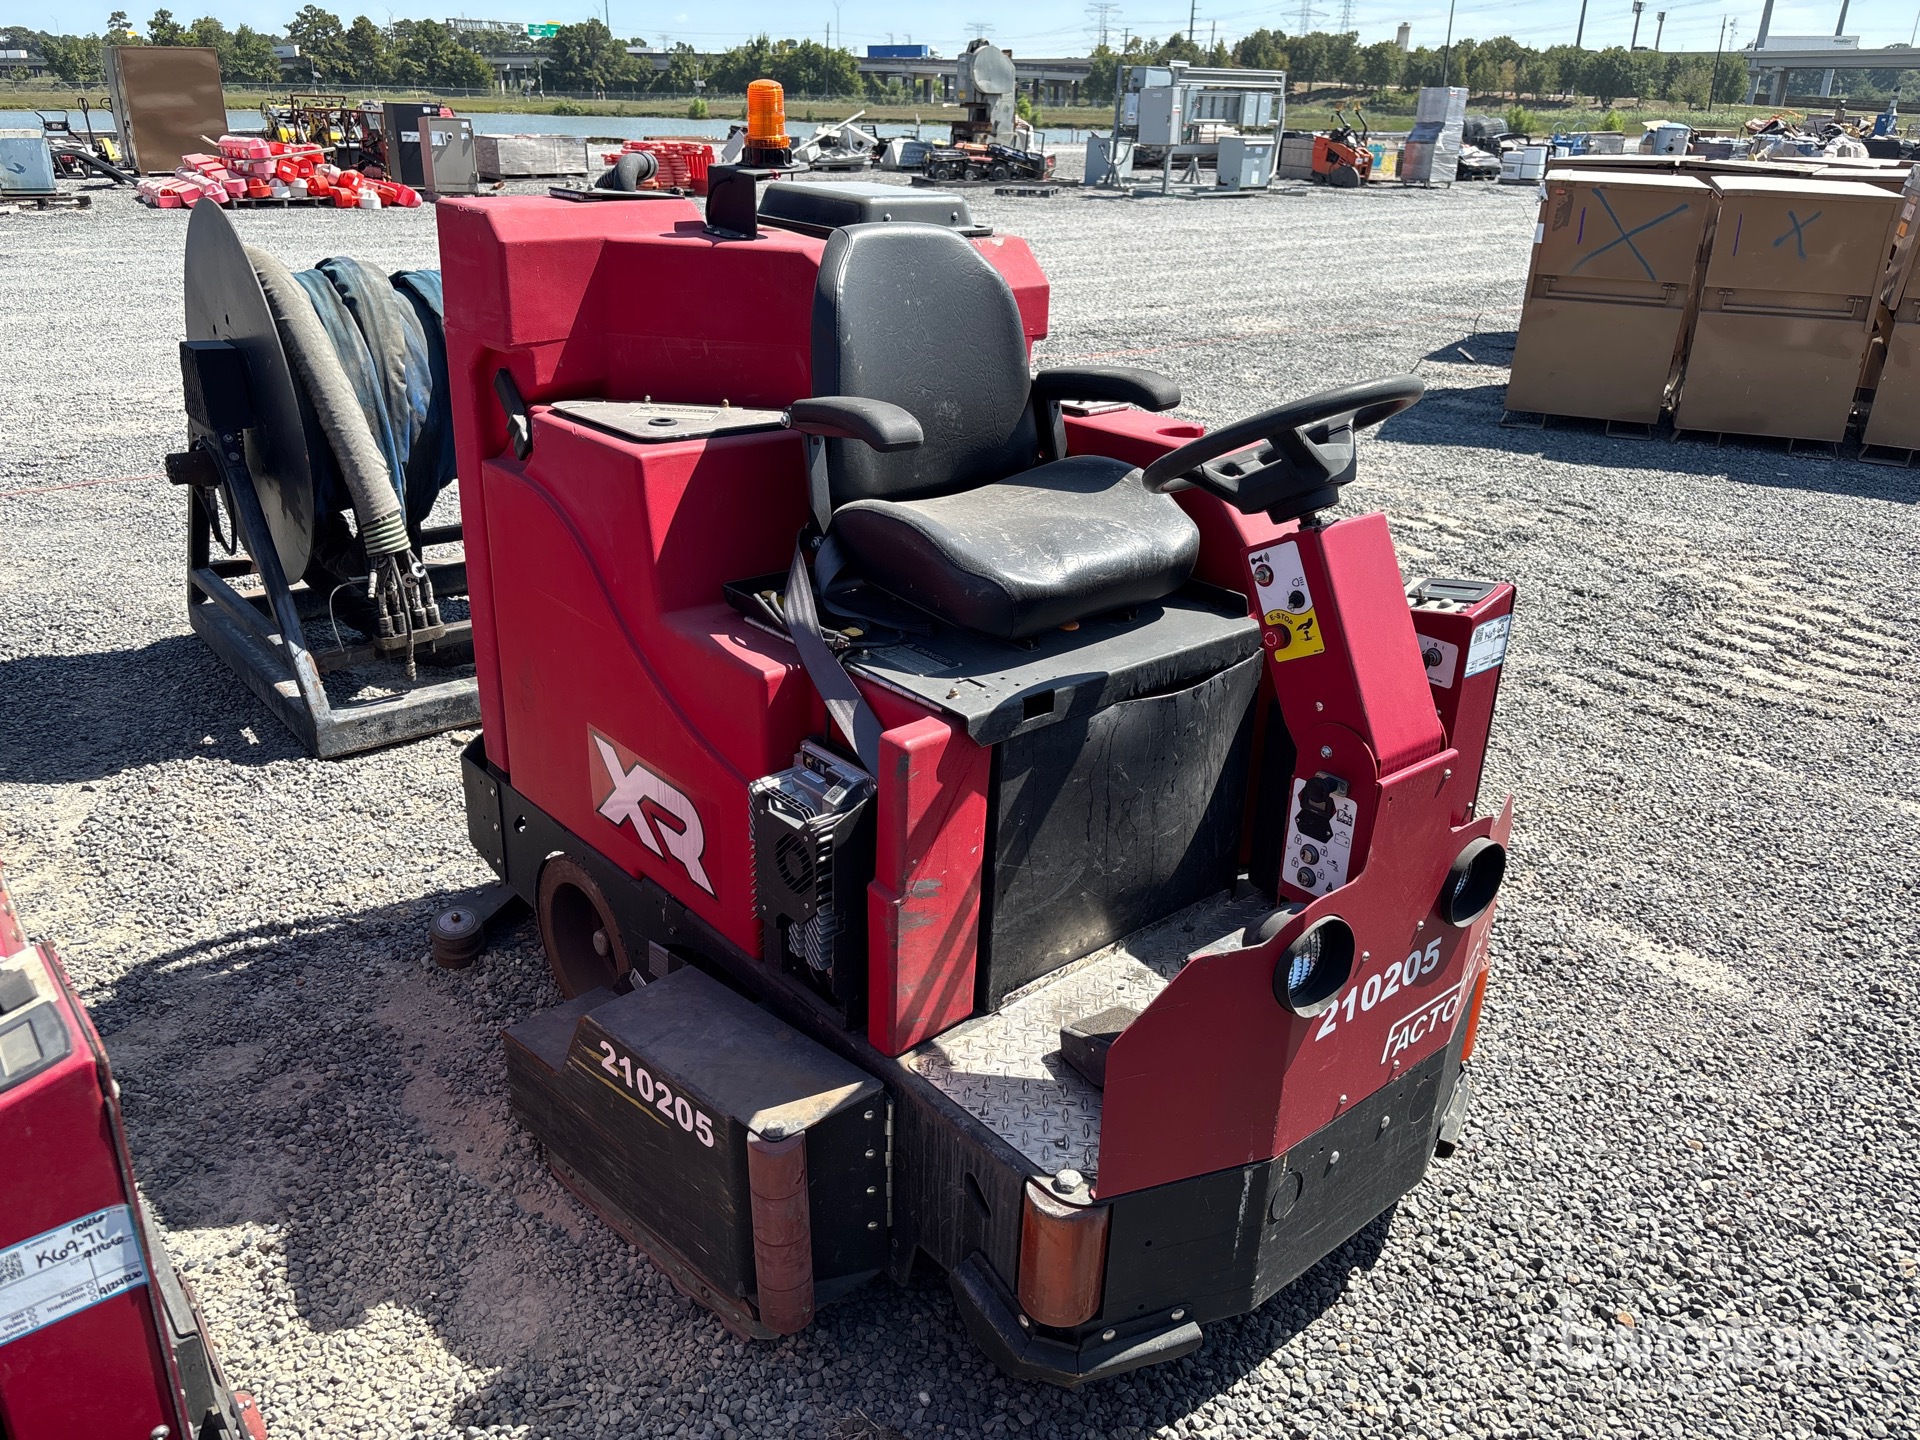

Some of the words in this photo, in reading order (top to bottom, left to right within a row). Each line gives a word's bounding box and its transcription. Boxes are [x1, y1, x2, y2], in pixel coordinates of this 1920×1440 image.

[1269, 612, 1294, 626] E-STOP
[1314, 936, 1442, 1042] 210205
[599, 1040, 715, 1148] 210205
[35, 1230, 105, 1268] K69-71
[47, 1293, 87, 1313] Inspection
